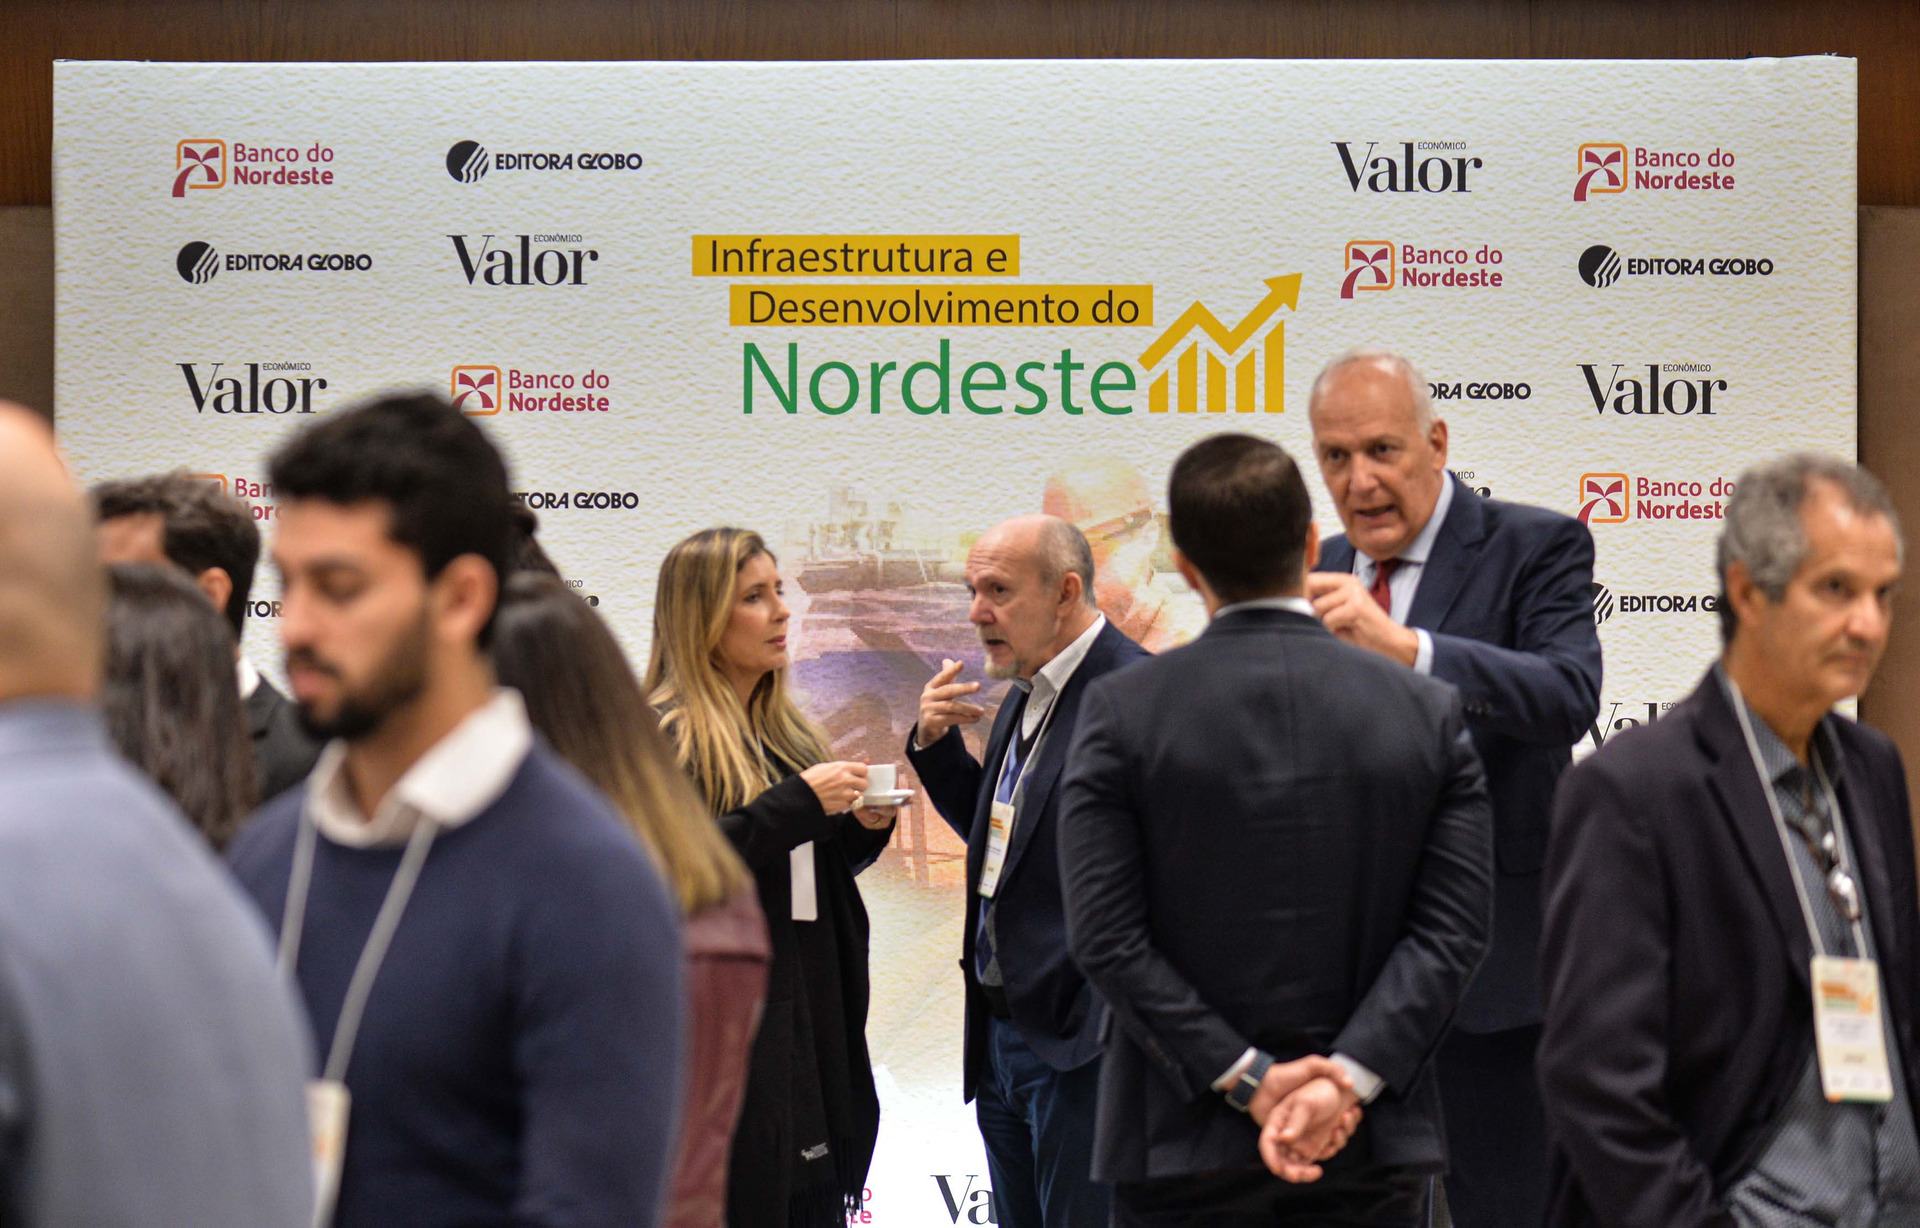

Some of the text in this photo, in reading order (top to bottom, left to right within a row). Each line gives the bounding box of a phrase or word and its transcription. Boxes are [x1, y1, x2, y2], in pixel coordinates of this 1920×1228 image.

[233, 142, 334, 163] Banco do
[1418, 141, 1467, 150] ECONÔMICO
[495, 152, 643, 171] EDITORA GLOBO
[1635, 147, 1735, 167] Banco do
[233, 165, 334, 186] Nordeste
[1330, 142, 1483, 193] Valor
[1635, 170, 1735, 190] Nordeste
[534, 233, 583, 243] ECONÔMICO
[225, 253, 373, 272] EDITORA GLOBO
[446, 234, 599, 286] Valor
[711, 237, 1008, 273] Infraestrutura e
[1403, 244, 1503, 264] Banco do
[1627, 257, 1774, 276] EDITORA GLOBO
[1403, 267, 1503, 287] Nordeste
[749, 289, 1140, 324] Desenvolvimento do
[262, 362, 312, 371] ECONÔMICO
[743, 338, 1136, 415] Nordeste
[1663, 363, 1712, 373] ECONÔMICO
[175, 362, 328, 414] Valor
[509, 369, 610, 390] Banco do
[1576, 363, 1728, 415] Valor
[1466, 382, 1532, 400] GLOBO
[508, 392, 610, 412] Nordeste
[235, 478, 275, 498] Ban
[1636, 477, 1737, 497] Banco do
[573, 492, 639, 509] GLOBO
[1620, 595, 1697, 612] EDITORA
